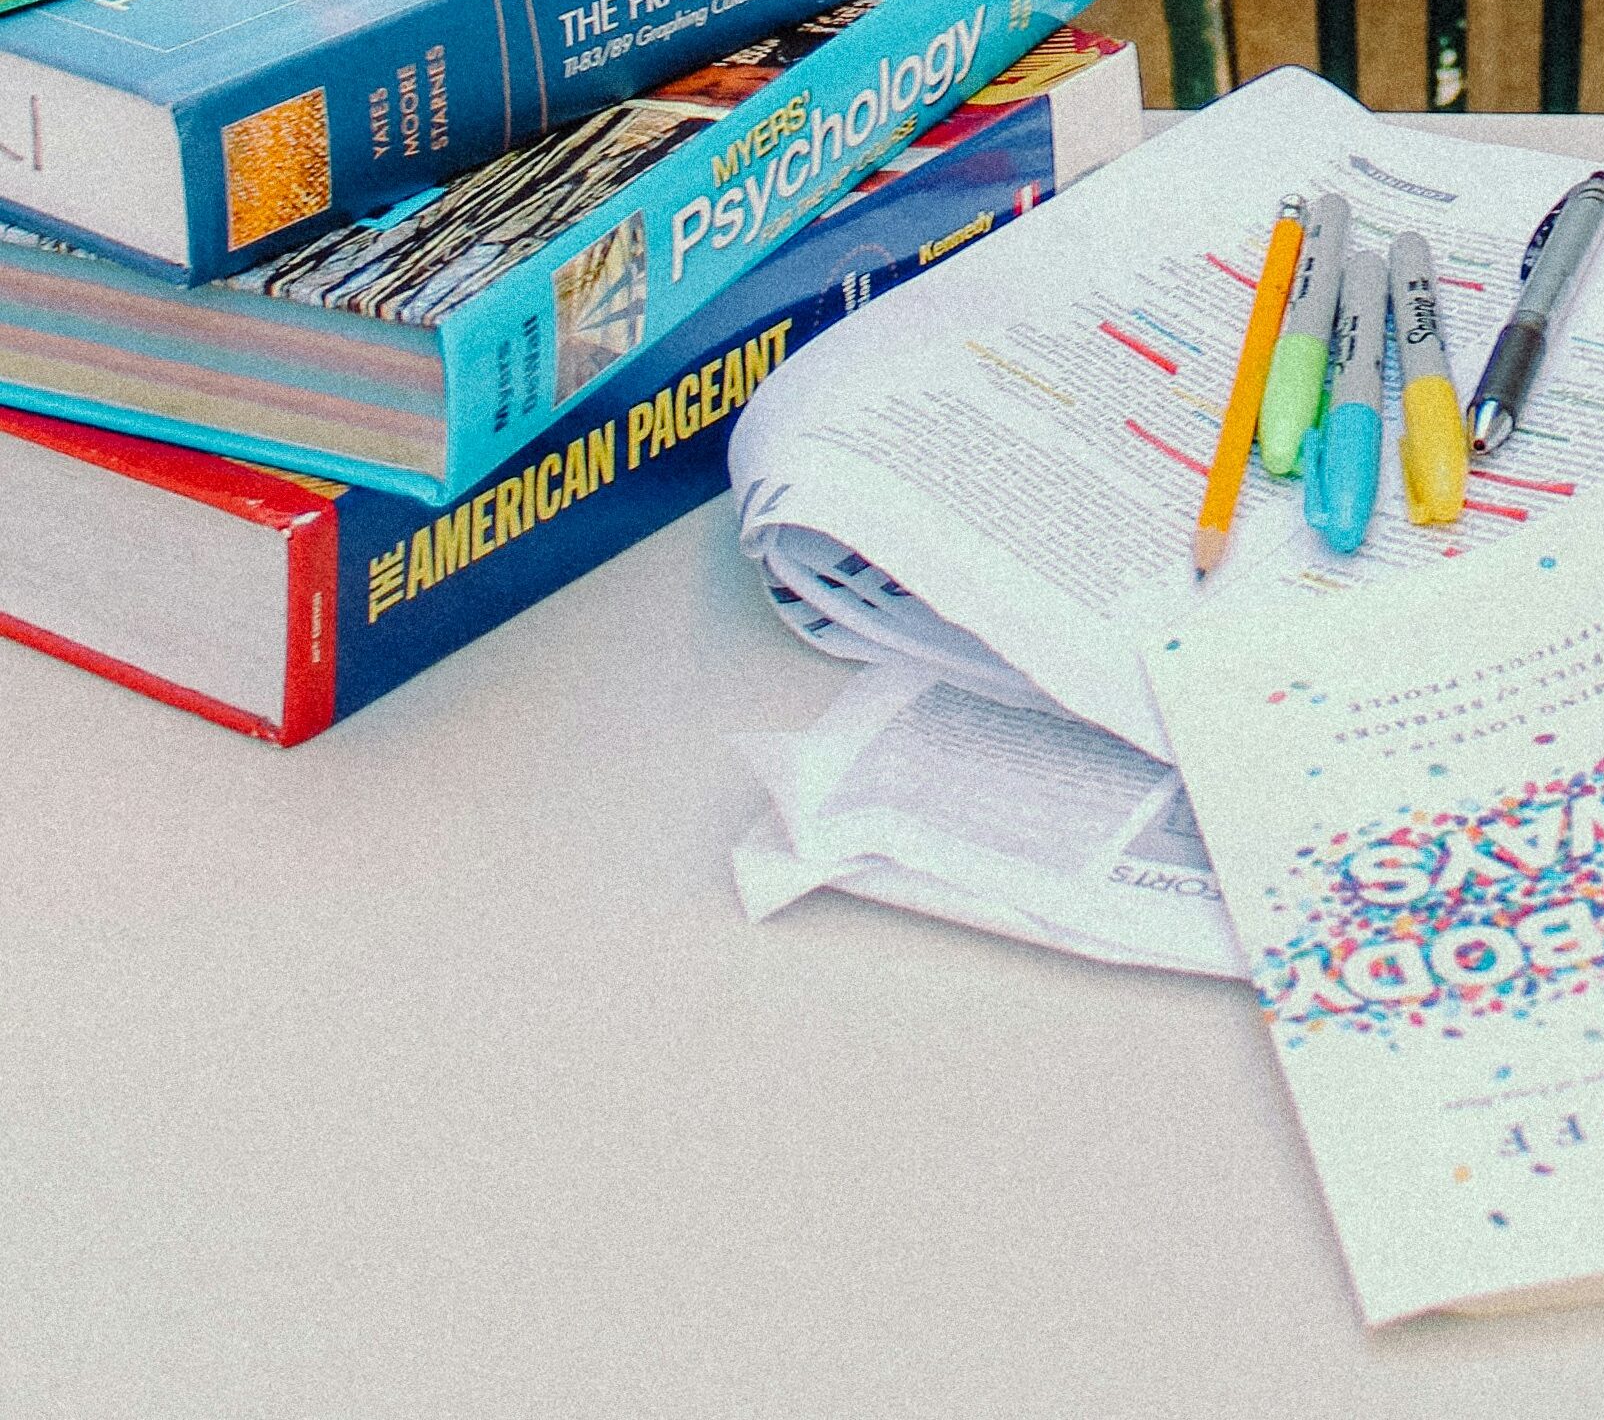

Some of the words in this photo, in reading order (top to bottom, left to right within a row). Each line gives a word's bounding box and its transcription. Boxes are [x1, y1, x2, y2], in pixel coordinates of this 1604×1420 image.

[635, 2, 707, 50] Graphing
[369, 87, 391, 161] YATES
[396, 64, 420, 157] MOORE
[425, 44, 448, 151] STARNES
[670, 4, 986, 282] Psychology
[918, 211, 995, 267] Kennedy
[368, 540, 406, 624] THE
[404, 420, 616, 601] AMERICAN
[627, 317, 794, 471] PAGEANT
[1349, 678, 1459, 712] PEOPLE
[1534, 651, 1603, 688] FULL
[1335, 698, 1484, 743] SETBACKS
[1453, 713, 1528, 743] LOVE
